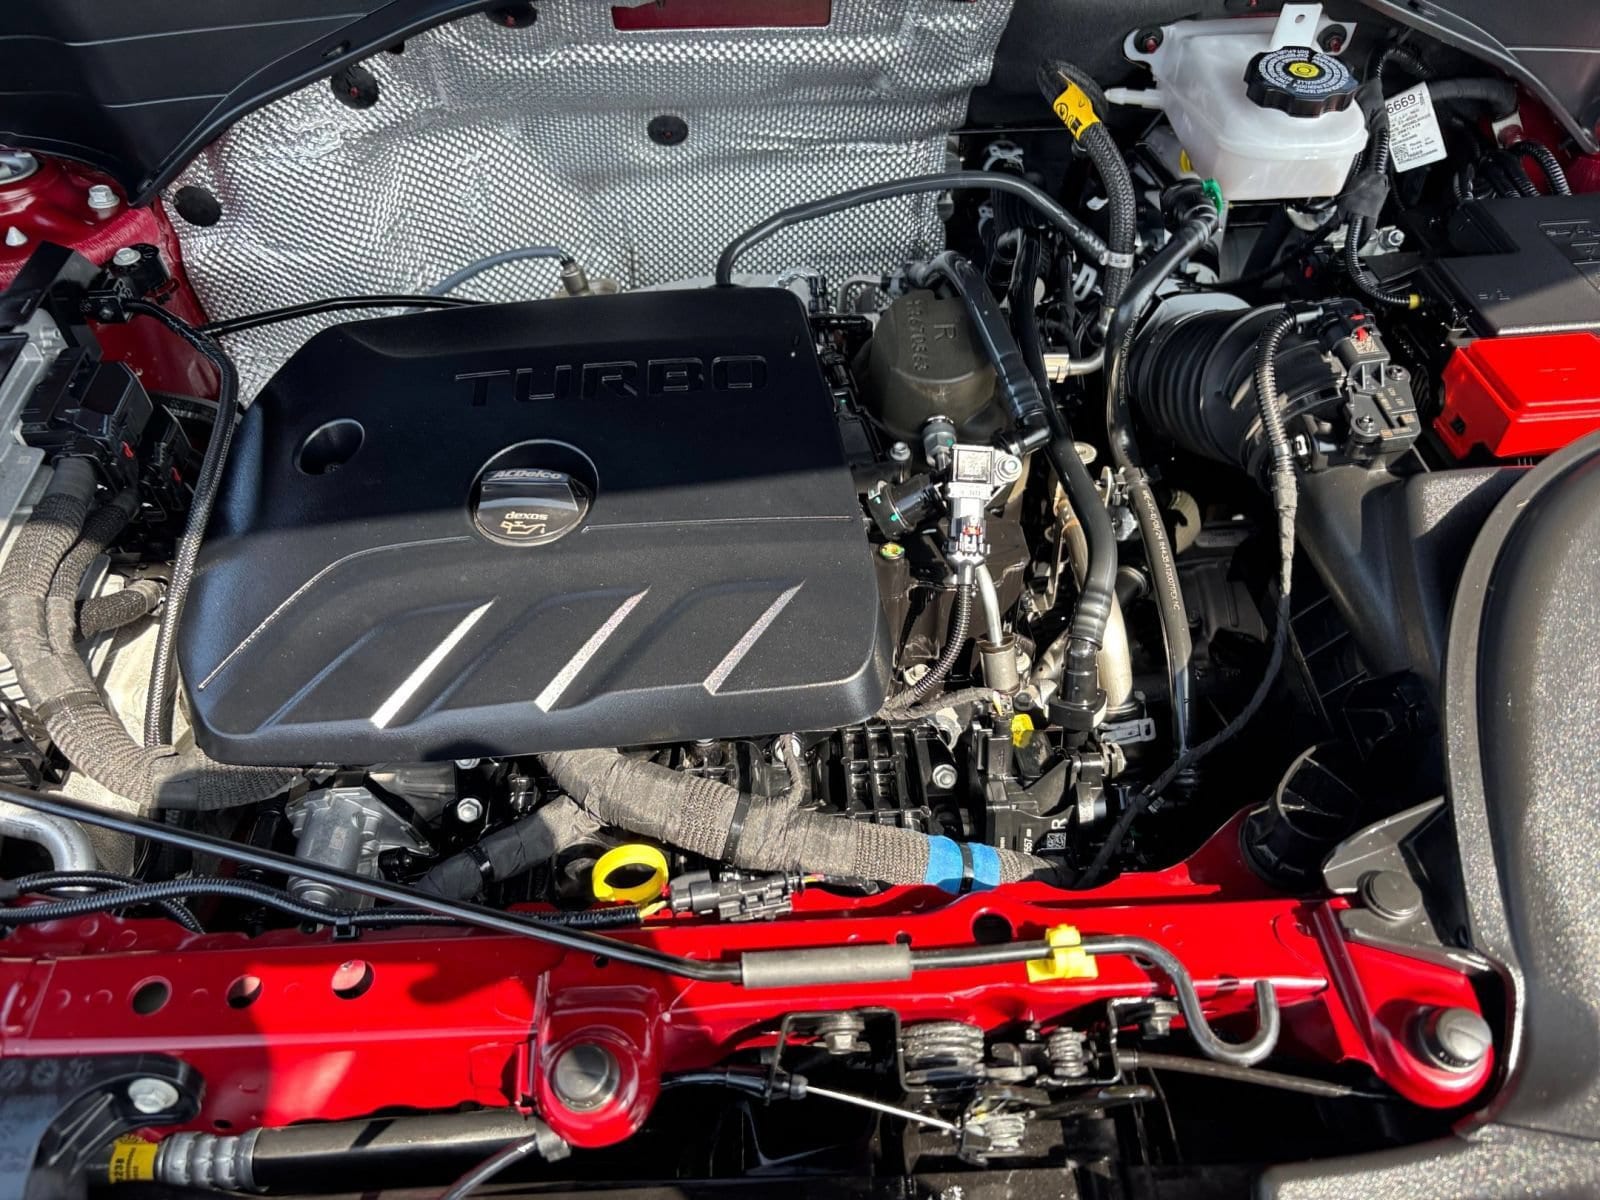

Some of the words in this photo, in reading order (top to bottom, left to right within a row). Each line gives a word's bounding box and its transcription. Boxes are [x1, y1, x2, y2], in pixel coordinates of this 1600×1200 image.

[933, 324, 956, 341] R
[455, 355, 767, 407] TURBO
[493, 469, 562, 480] ACDelco
[504, 511, 549, 521] dexos
[1051, 818, 1068, 830] R
